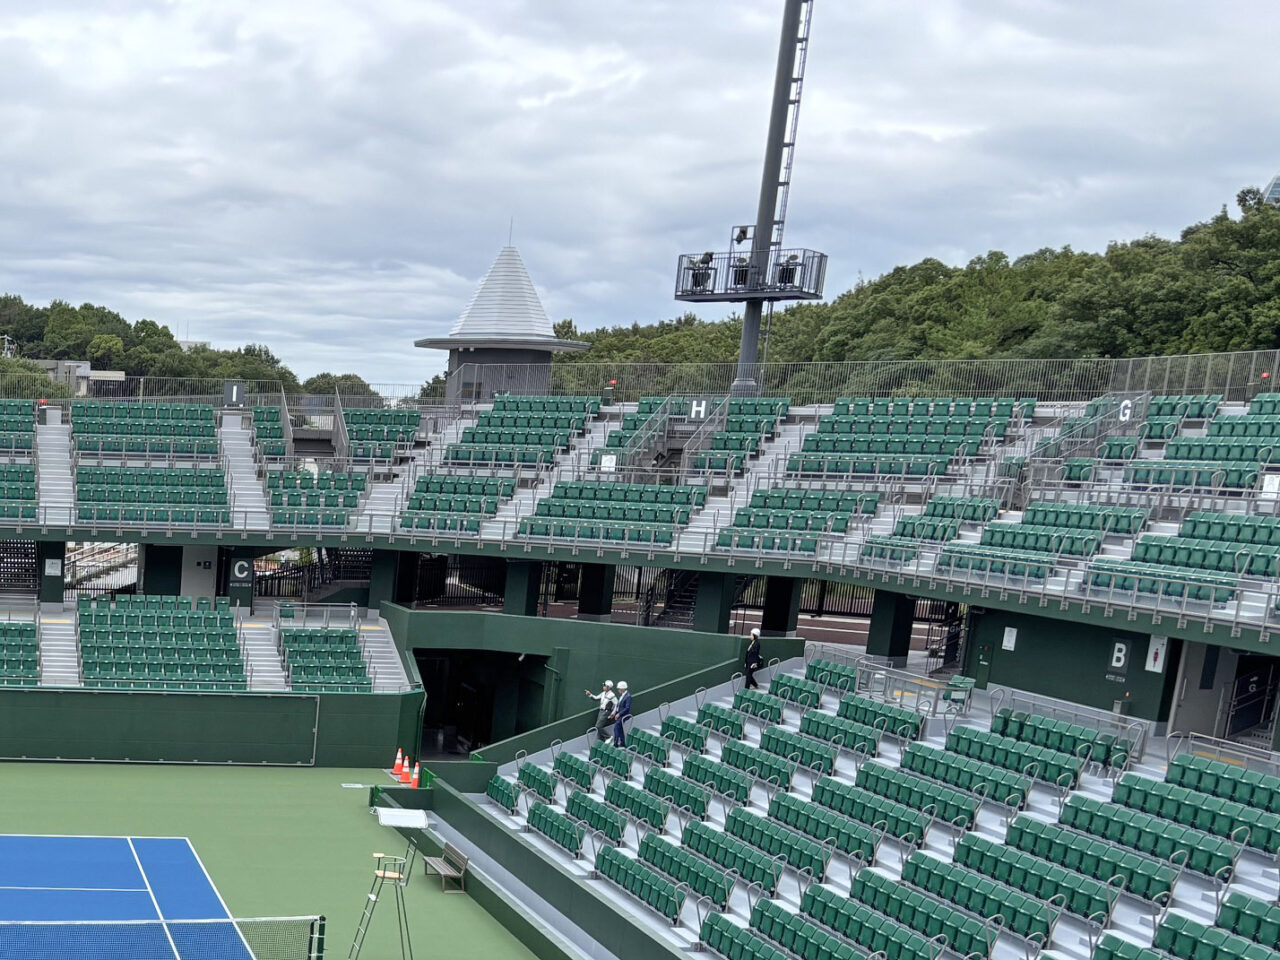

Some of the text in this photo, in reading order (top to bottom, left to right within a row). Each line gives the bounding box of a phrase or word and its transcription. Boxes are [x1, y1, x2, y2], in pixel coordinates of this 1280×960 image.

[690, 400, 706, 418] H
[1119, 399, 1131, 421] G
[234, 560, 249, 578] C
[1111, 642, 1126, 667] B
[1248, 684, 1257, 693] G
